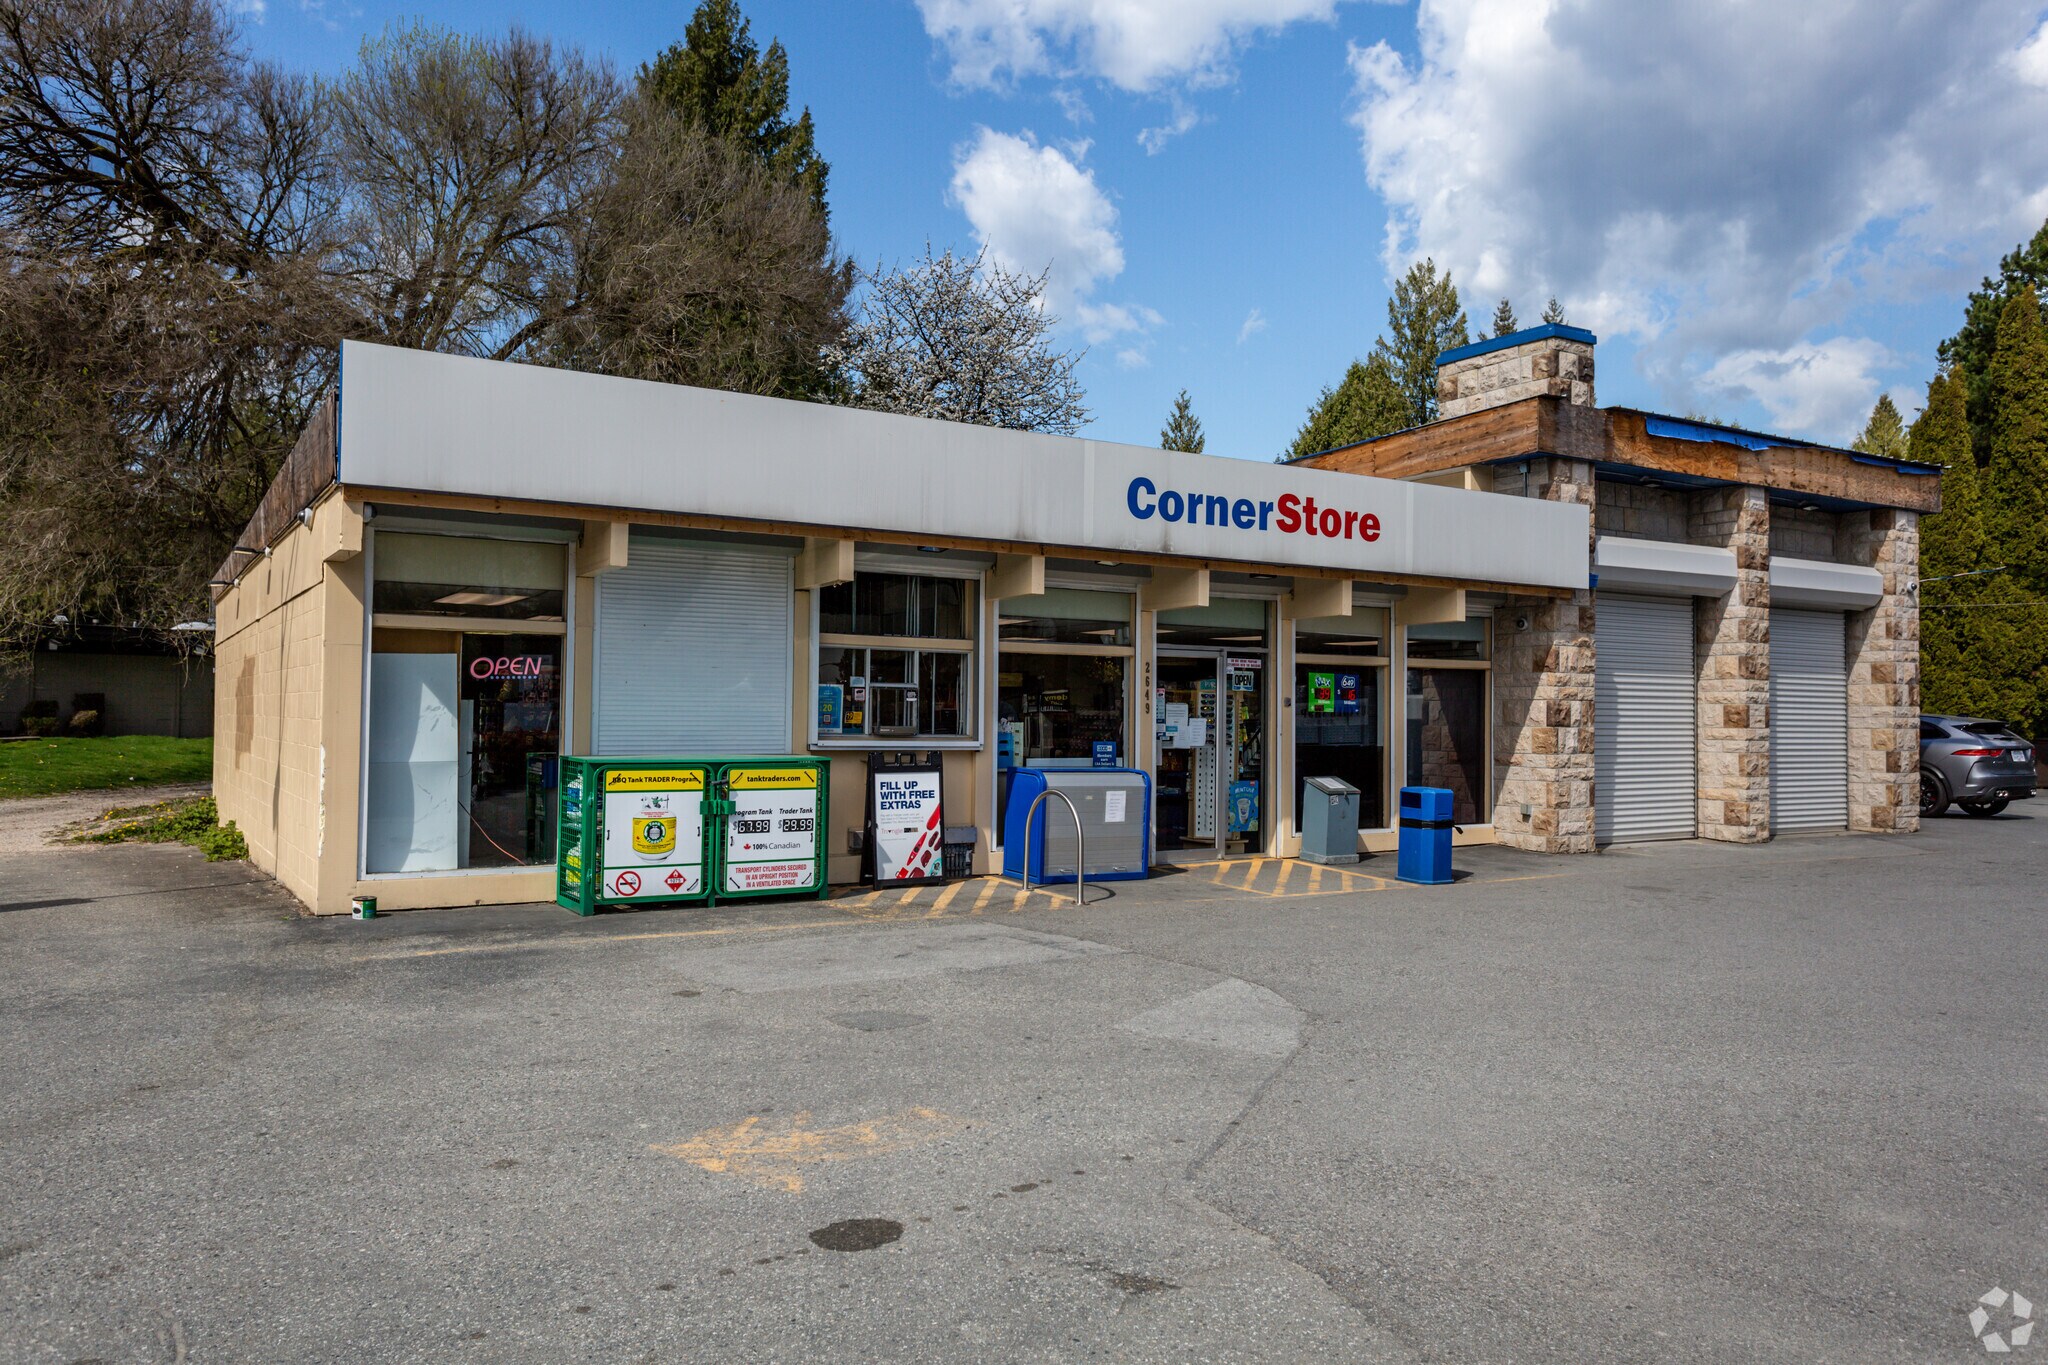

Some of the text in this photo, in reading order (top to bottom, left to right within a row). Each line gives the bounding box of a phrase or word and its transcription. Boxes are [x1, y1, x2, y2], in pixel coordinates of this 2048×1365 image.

[1127, 476, 1381, 542] CornerStore
[470, 657, 542, 679] OPEN
[1235, 675, 1252, 686] OPEN
[880, 781, 918, 790] FILL UP
[880, 790, 935, 800] WITH FREE
[881, 800, 921, 810] EXTRAS
[732, 809, 757, 817] rogram
